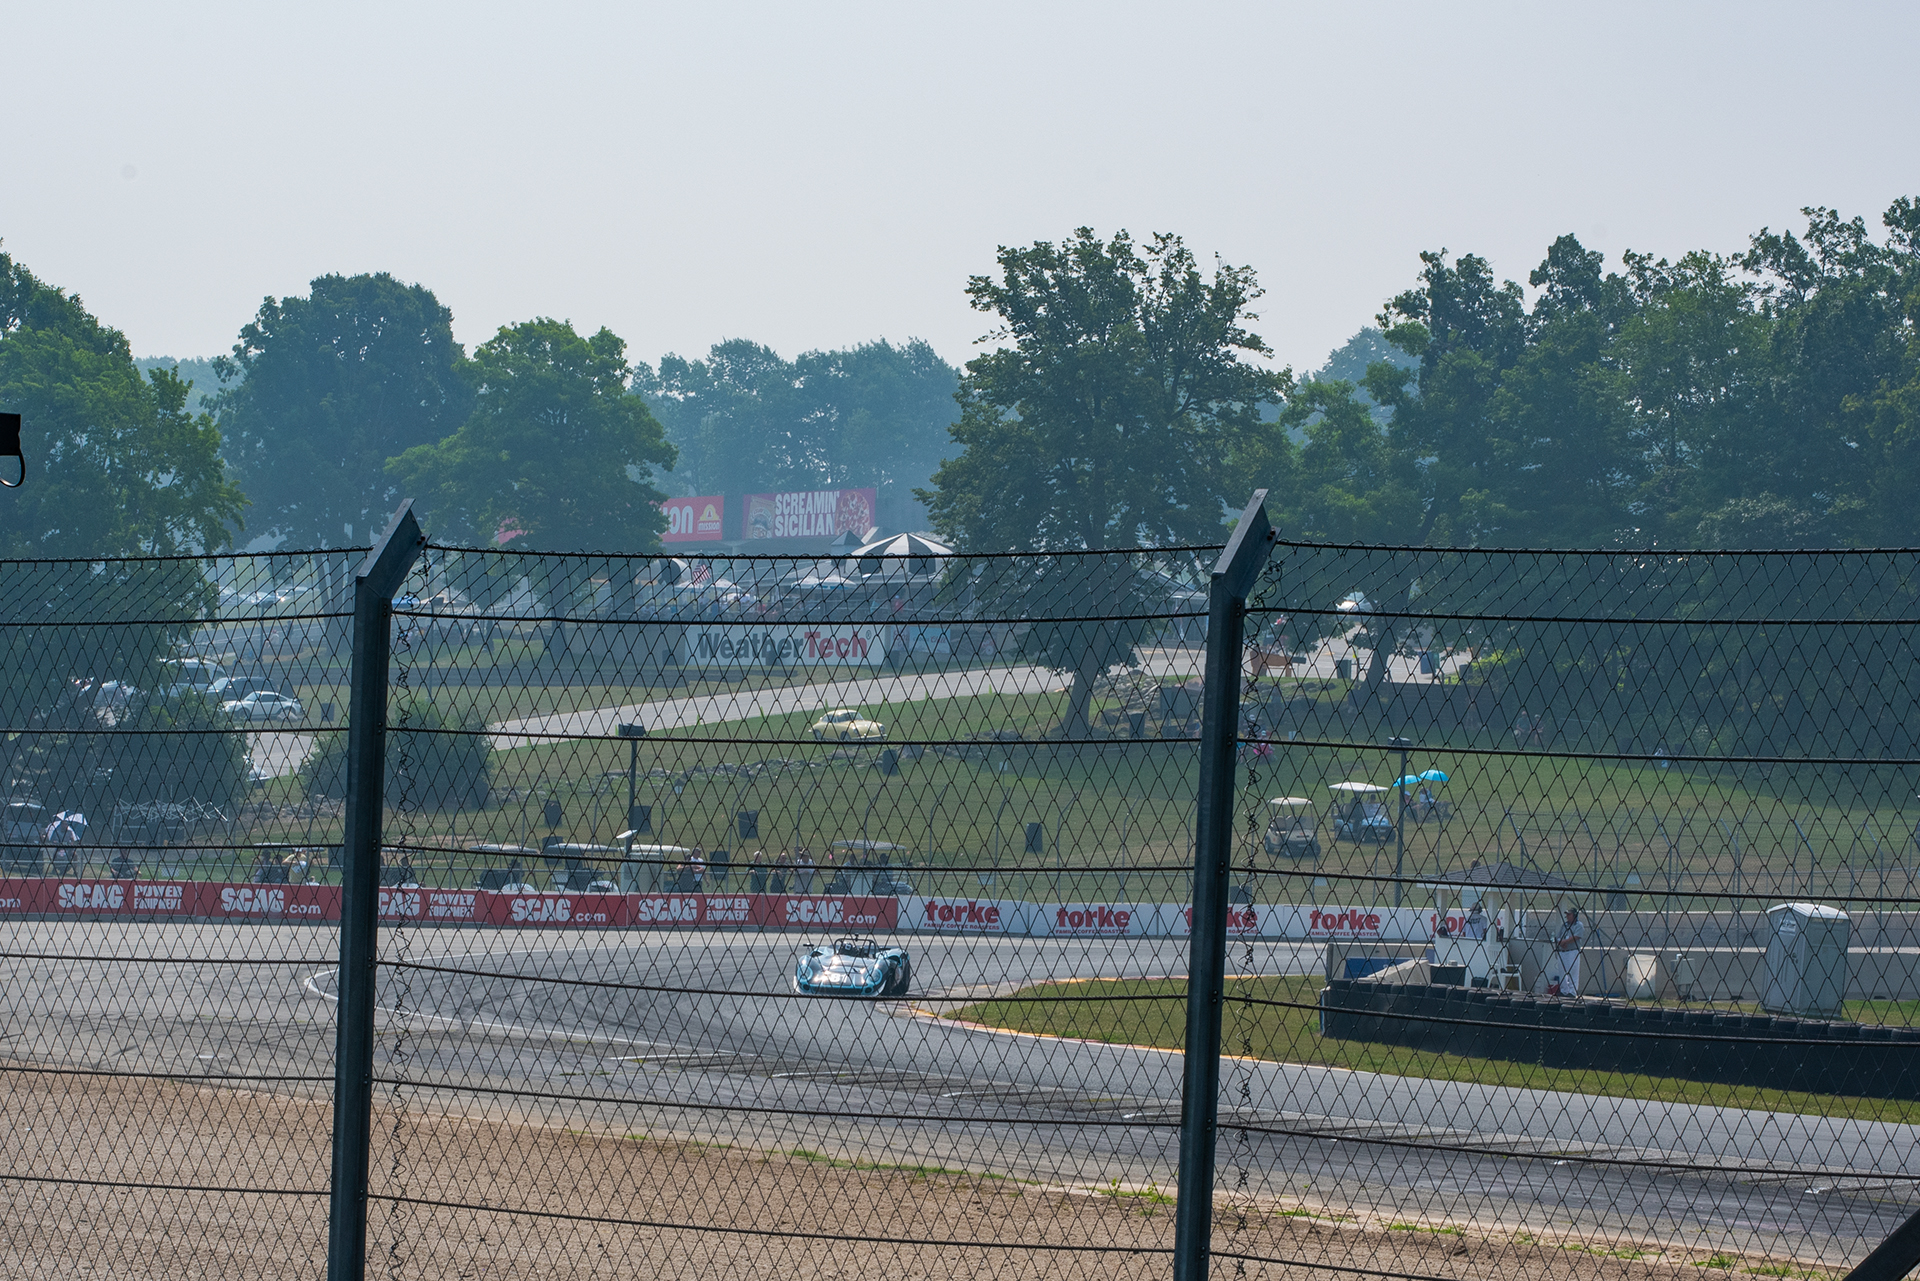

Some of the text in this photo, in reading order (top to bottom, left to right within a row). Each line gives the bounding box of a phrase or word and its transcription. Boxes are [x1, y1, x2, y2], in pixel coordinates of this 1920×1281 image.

[774, 490, 841, 516] SCREAMIN'
[774, 513, 836, 538] SICILIAN
[58, 883, 125, 910] SCAG
[133, 884, 183, 898] POWER
[429, 893, 476, 906] POWER
[133, 897, 182, 911] EQUIPMENT
[377, 891, 421, 917] CAG
[429, 905, 476, 919] EQUIPMENT
[638, 897, 698, 922] SCAG
[706, 897, 751, 910] POWER
[925, 900, 1001, 924] torke
[706, 909, 750, 922] EQUIPMENT
[1056, 905, 1131, 929] torke
[1185, 906, 1258, 928] tke
[1309, 909, 1381, 931] torke
